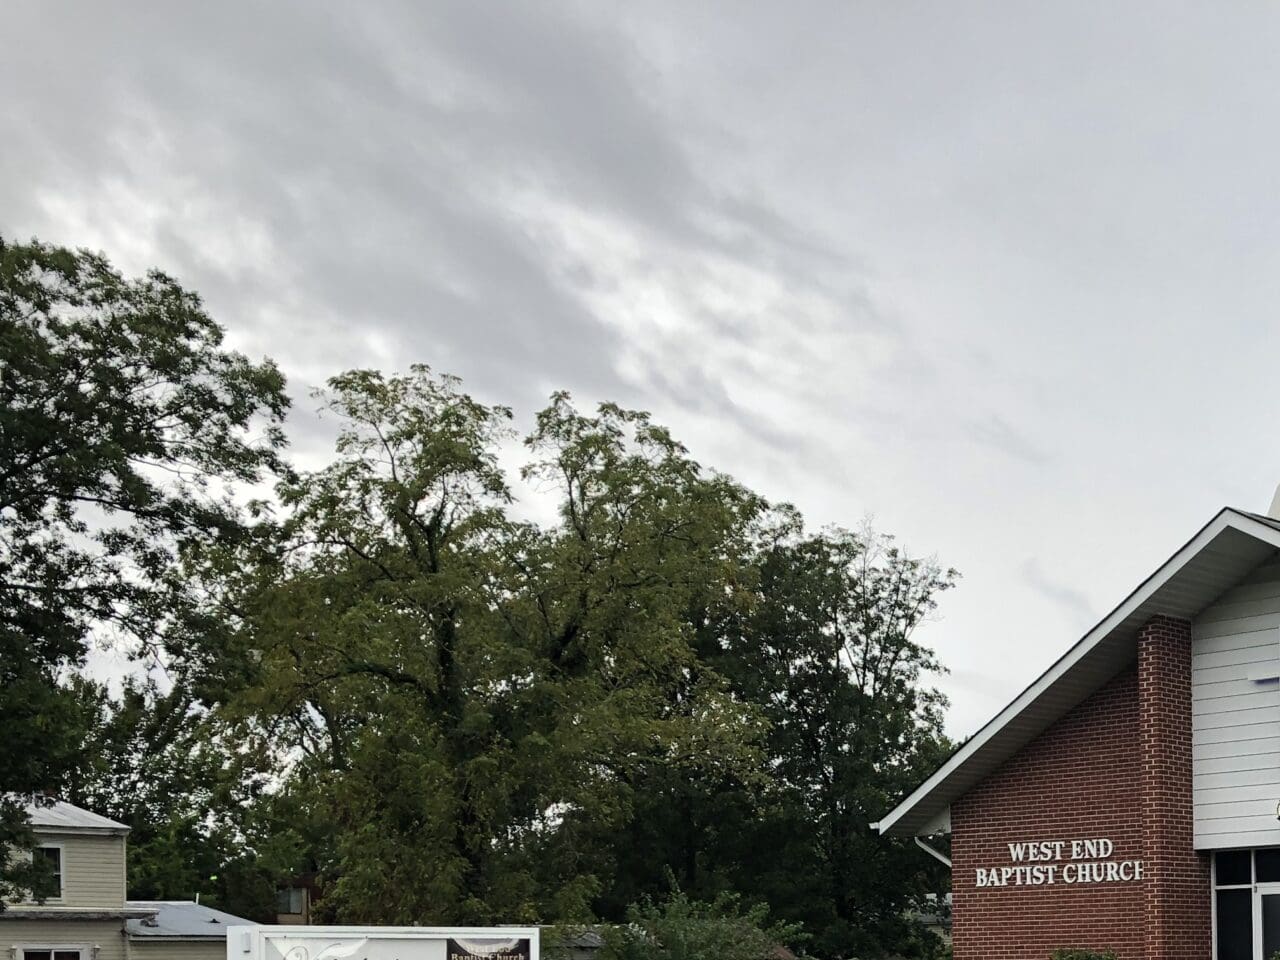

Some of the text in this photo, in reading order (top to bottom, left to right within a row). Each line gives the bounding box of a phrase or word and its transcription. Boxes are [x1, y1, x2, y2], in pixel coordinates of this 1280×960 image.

[1008, 838, 1113, 862] WEST END
[976, 860, 1144, 887] BAPTIST CHURCH
